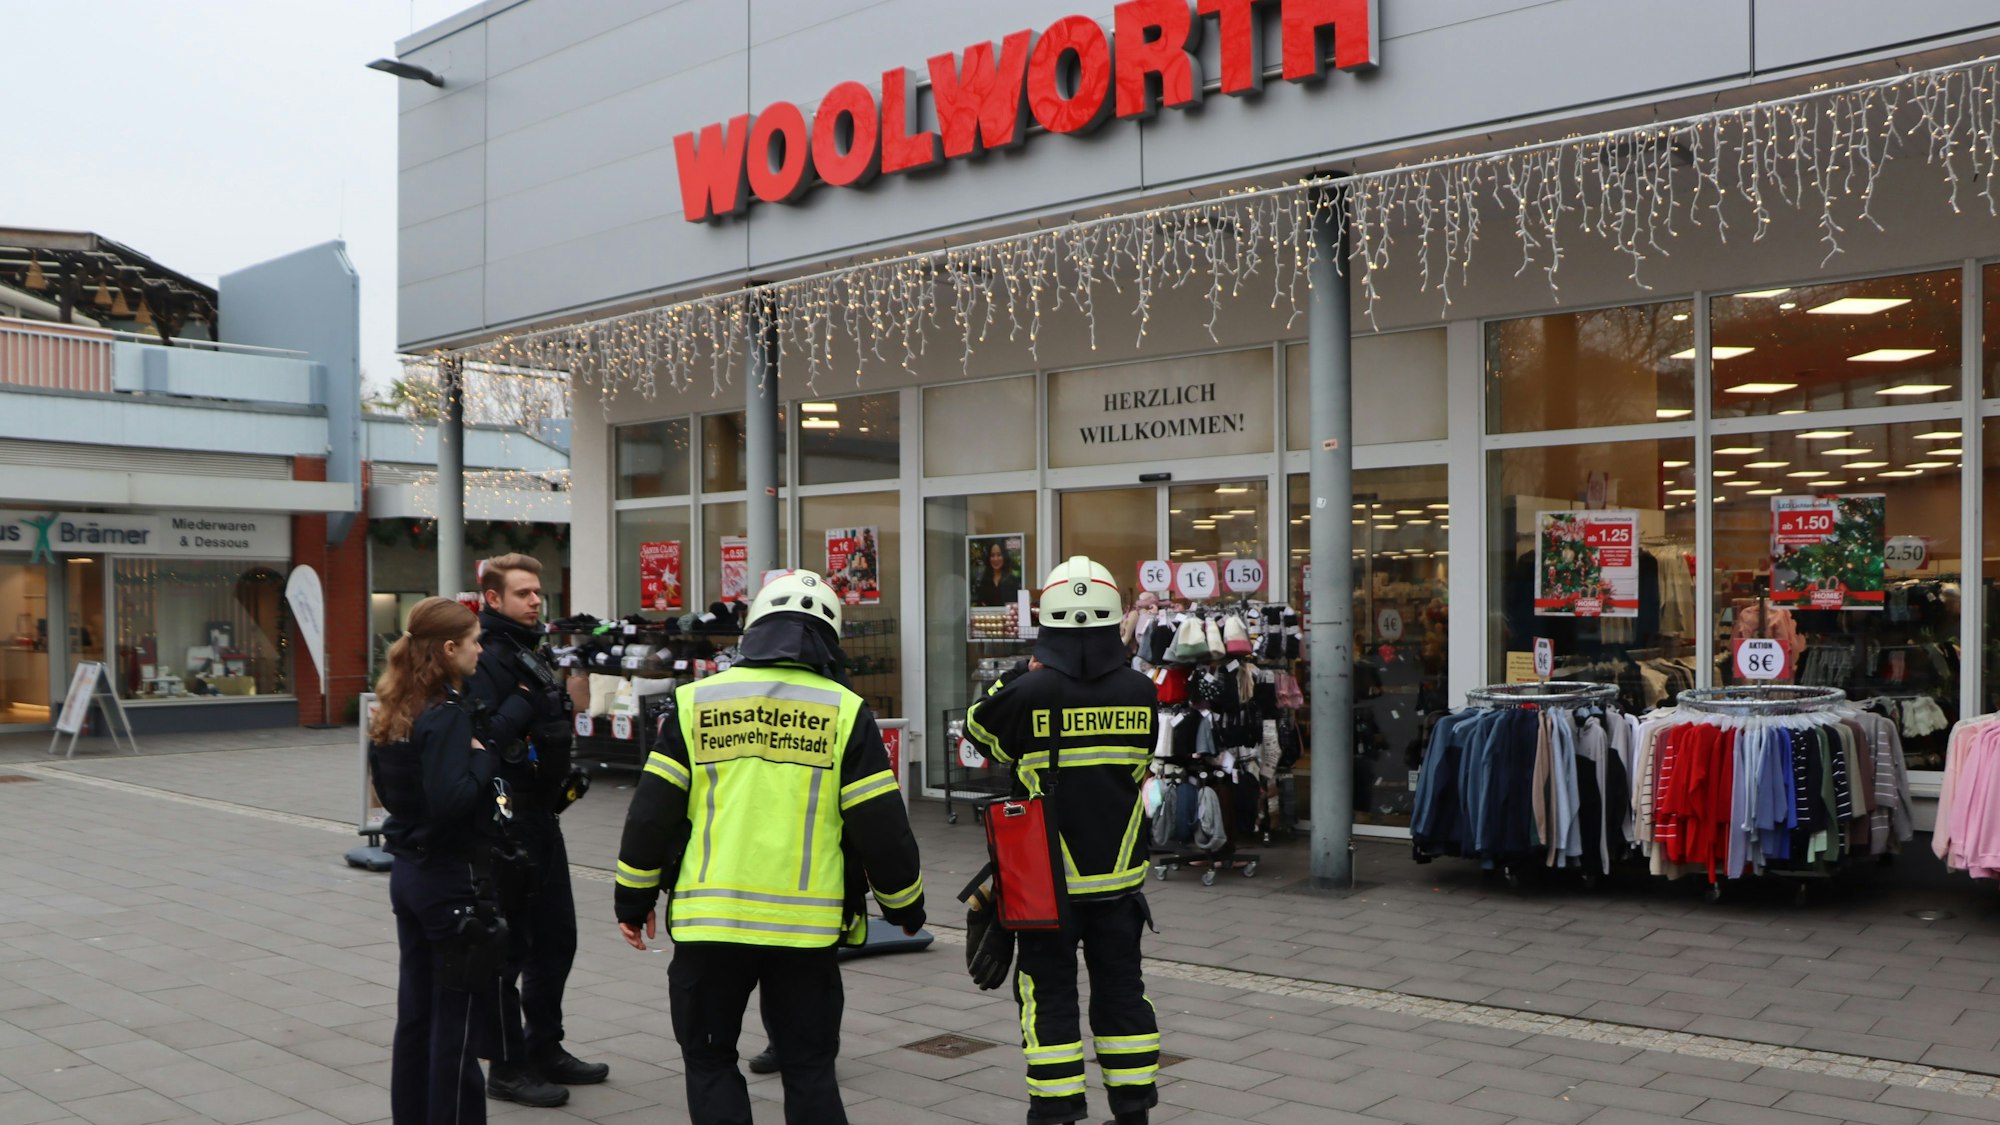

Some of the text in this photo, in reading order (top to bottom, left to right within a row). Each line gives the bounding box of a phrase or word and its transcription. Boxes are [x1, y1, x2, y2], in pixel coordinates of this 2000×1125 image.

[673, 0, 1378, 222] WOOLWORTH
[1104, 383, 1216, 412] HERZLICH
[1080, 413, 1244, 444] WILLKOMMEN!
[172, 518, 256, 532] Miederwaren
[1796, 516, 1829, 530] 1.50
[60, 522, 150, 545] Brämer
[1600, 528, 1629, 542] 1.25
[180, 536, 249, 549] & Dessous
[839, 541, 849, 551] 1€
[1886, 545, 1923, 560] 2.50
[1147, 568, 1164, 583] 5€
[1186, 571, 1206, 588] 1€
[1227, 568, 1261, 583] 1.50
[1383, 617, 1399, 631] 4€
[1538, 652, 1548, 670] 8€
[1749, 653, 1774, 671] 8€
[700, 705, 830, 731] Einsatzleiter
[1036, 711, 1148, 732] FUERWEHR
[701, 727, 828, 754] Feuerwehr Erftstadt
[966, 745, 979, 759] 3€
